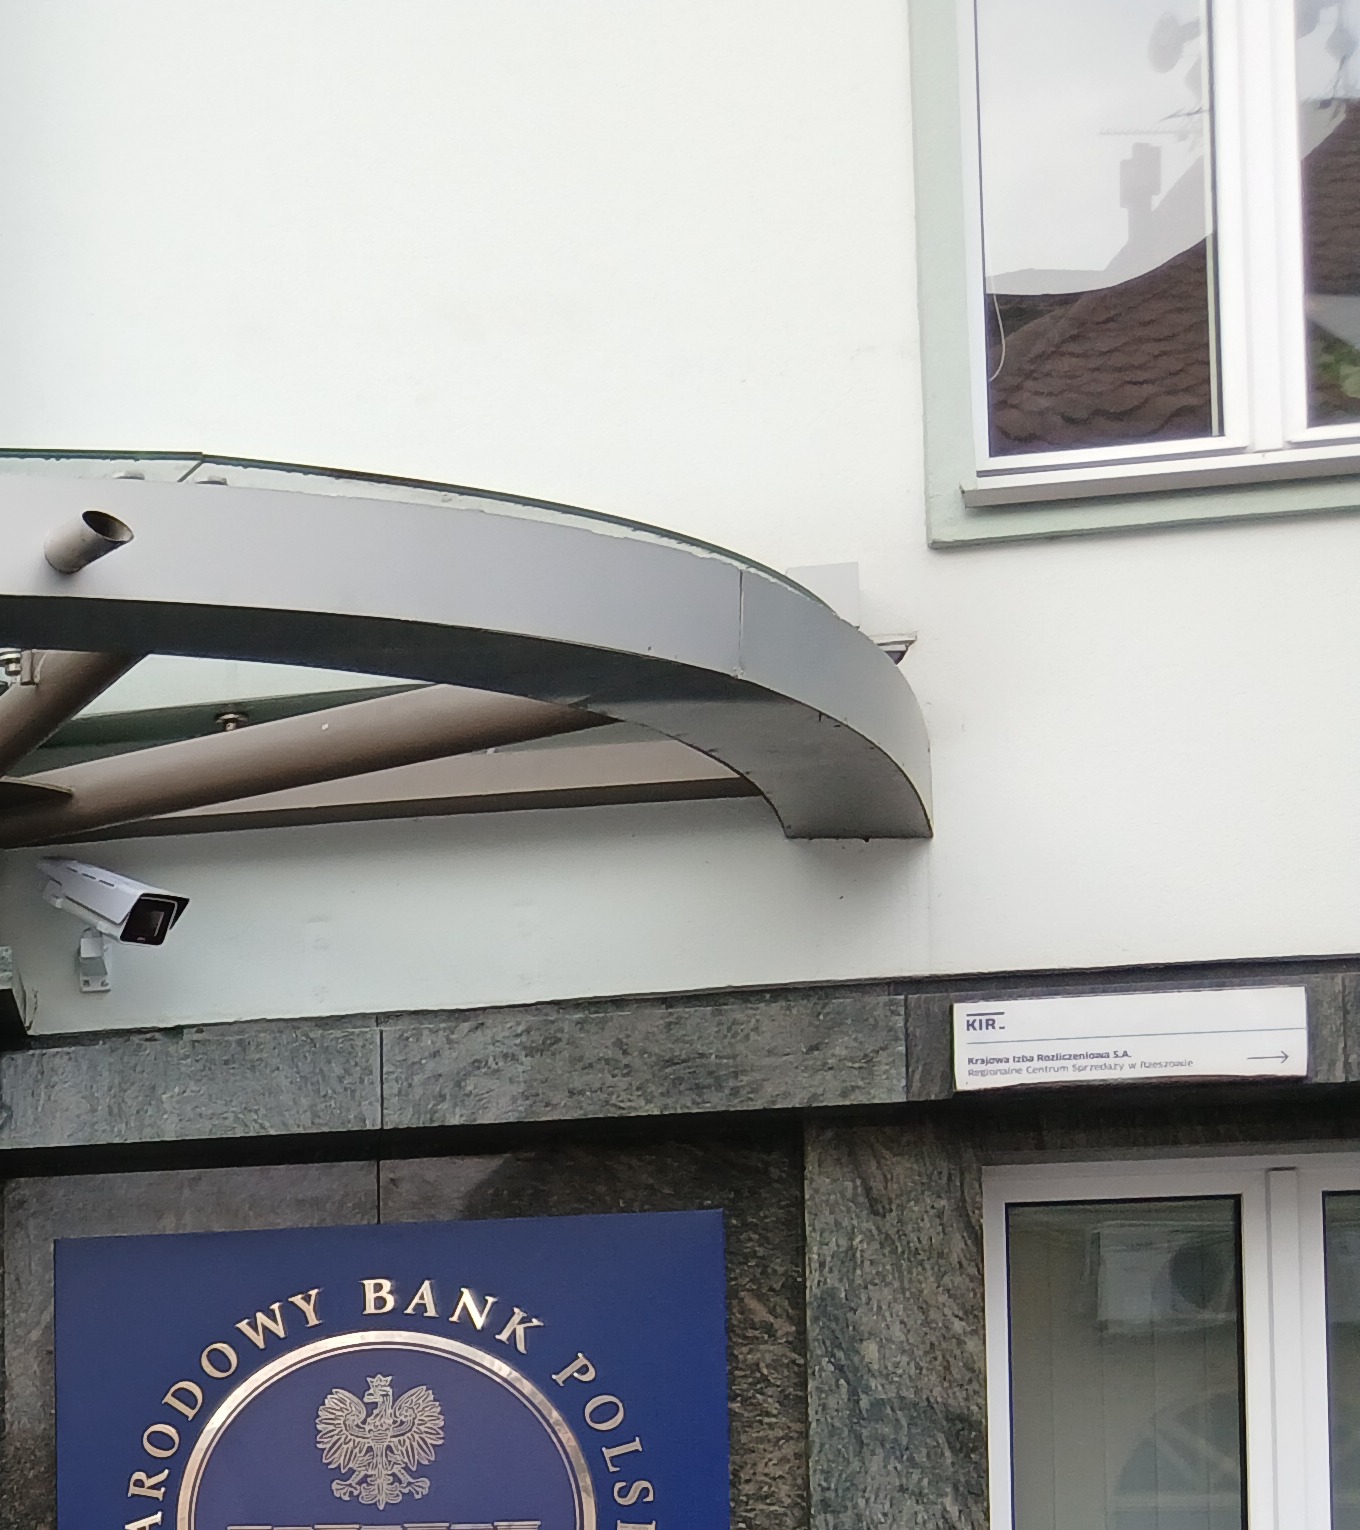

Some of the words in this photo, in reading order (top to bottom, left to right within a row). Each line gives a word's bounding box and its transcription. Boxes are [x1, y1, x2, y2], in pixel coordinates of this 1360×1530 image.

[967, 1056, 1010, 1066] Krajowa
[1012, 1054, 1034, 1063] Izba
[1026, 1064, 1069, 1074] Centrum
[359, 1278, 545, 1354] BANK
